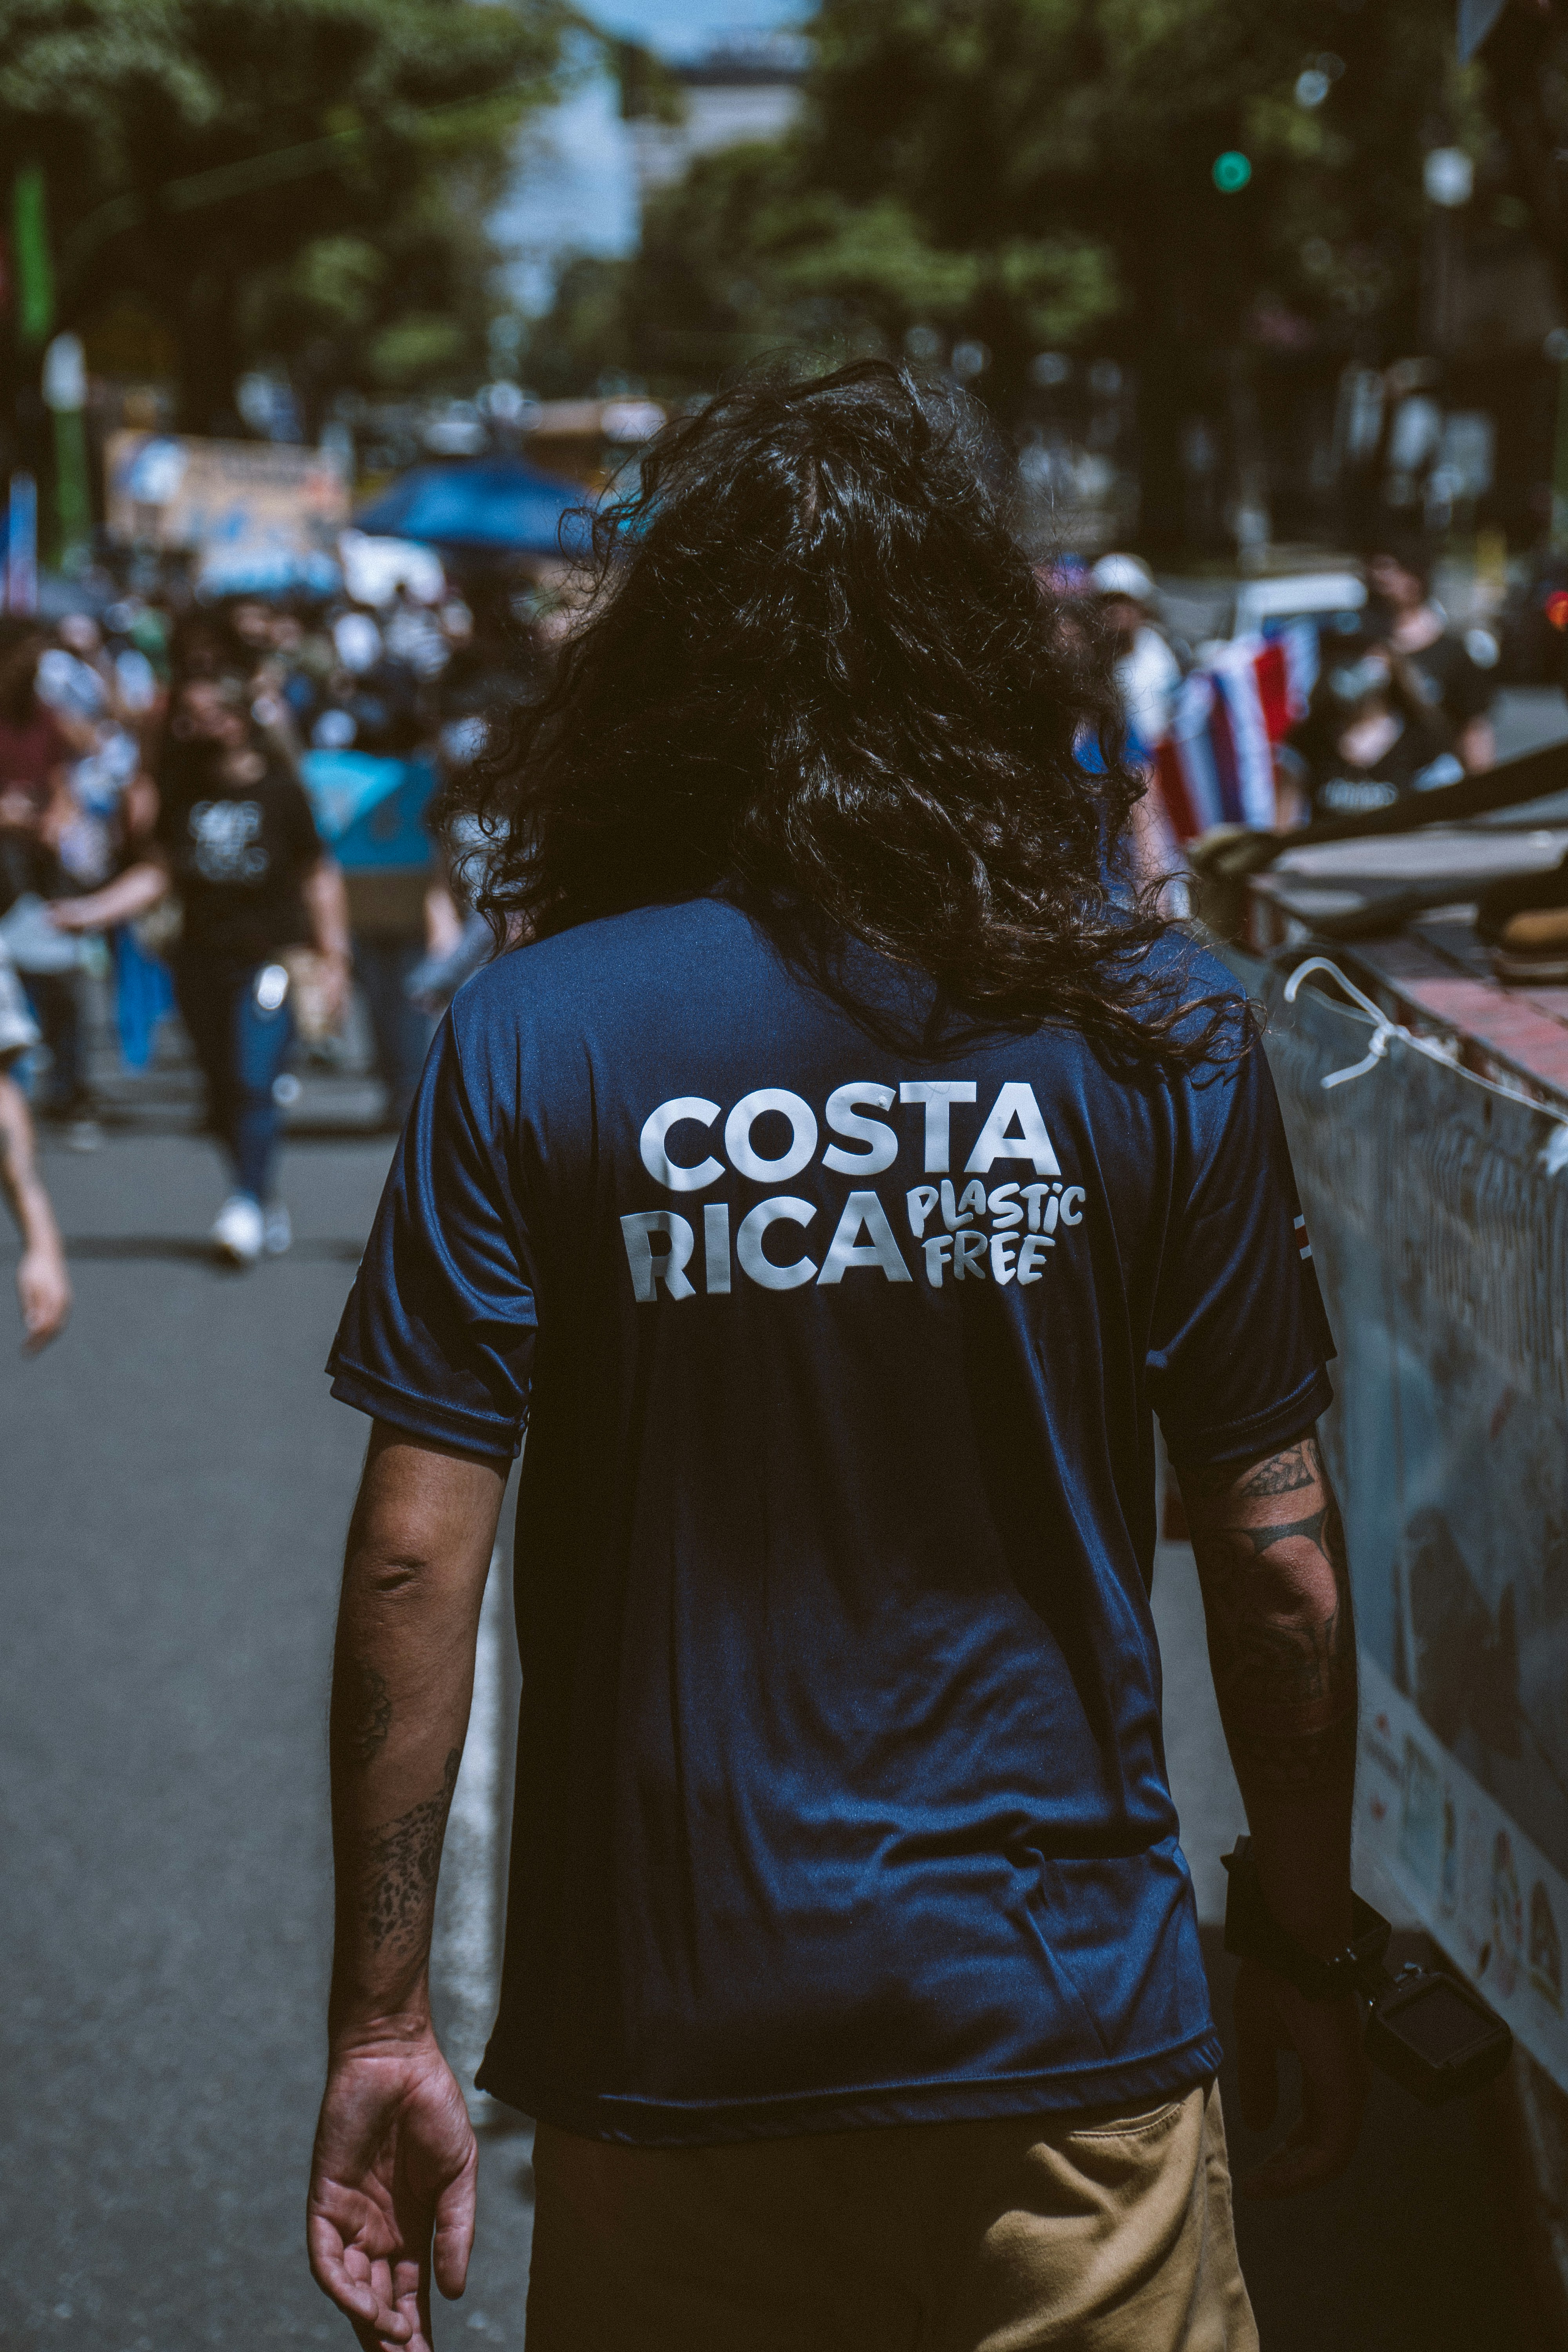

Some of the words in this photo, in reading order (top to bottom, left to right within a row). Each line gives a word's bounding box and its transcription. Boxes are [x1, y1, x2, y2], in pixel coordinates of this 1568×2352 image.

[640, 1081, 1062, 1192] COSTA
[620, 1191, 913, 1303] RICA
[921, 1230, 1056, 1288] FREE
